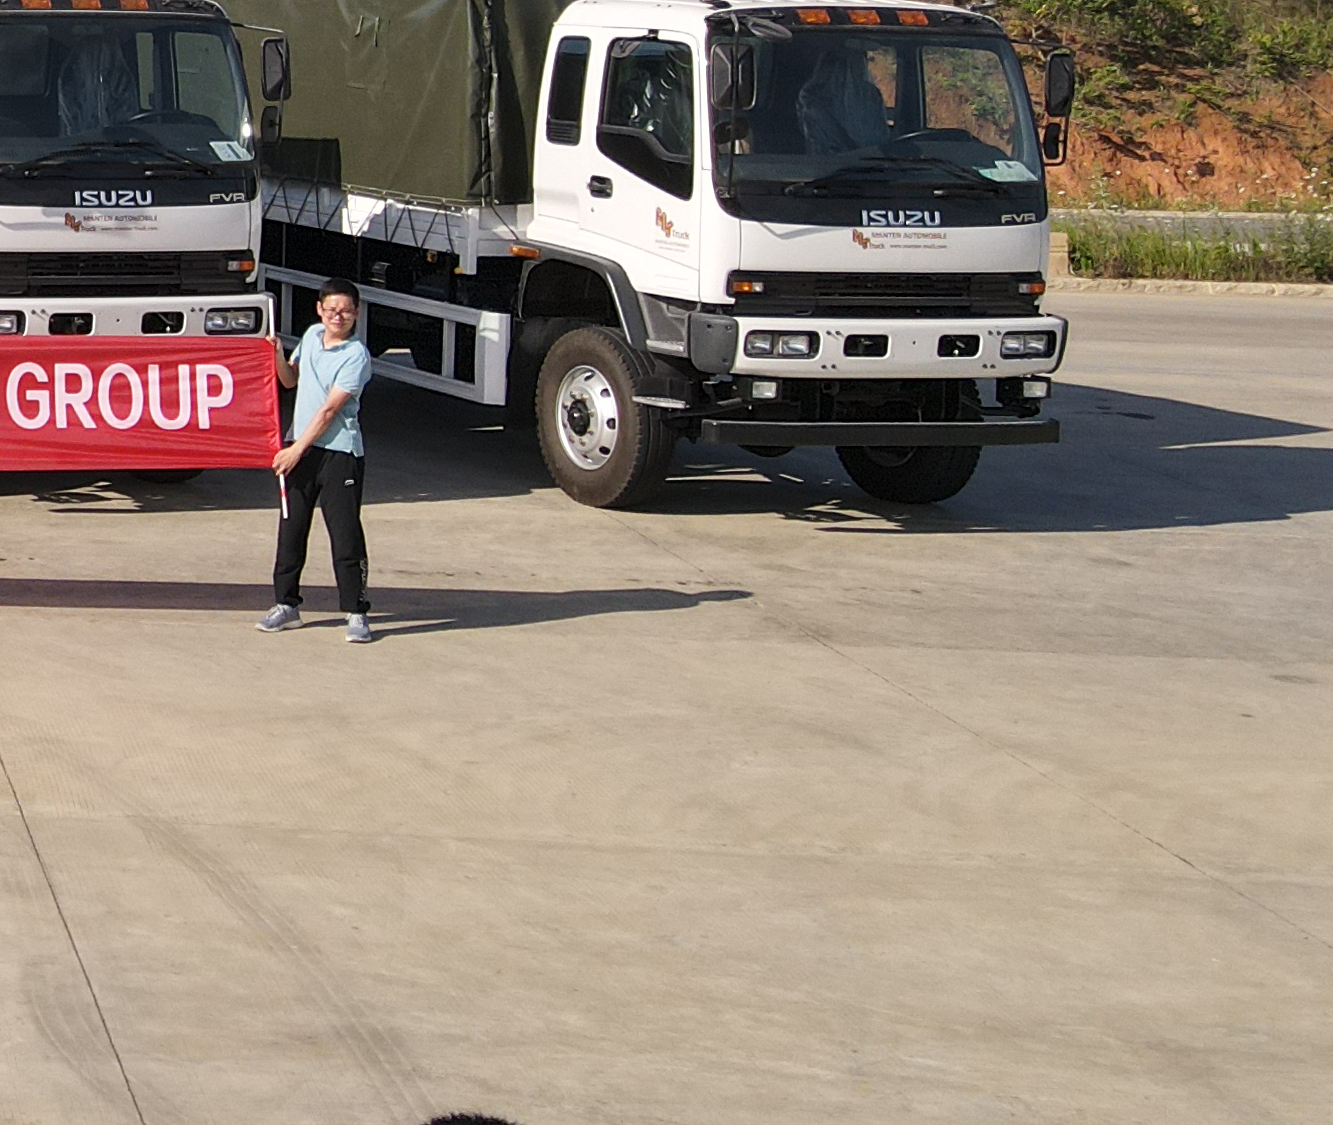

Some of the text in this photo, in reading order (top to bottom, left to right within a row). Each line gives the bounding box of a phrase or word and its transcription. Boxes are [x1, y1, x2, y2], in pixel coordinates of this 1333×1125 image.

[74, 190, 153, 207] ISUZU
[209, 192, 245, 203] FVR
[861, 209, 941, 226] ISUZU
[1001, 213, 1036, 224] FVR
[6, 361, 234, 430] GROUP
